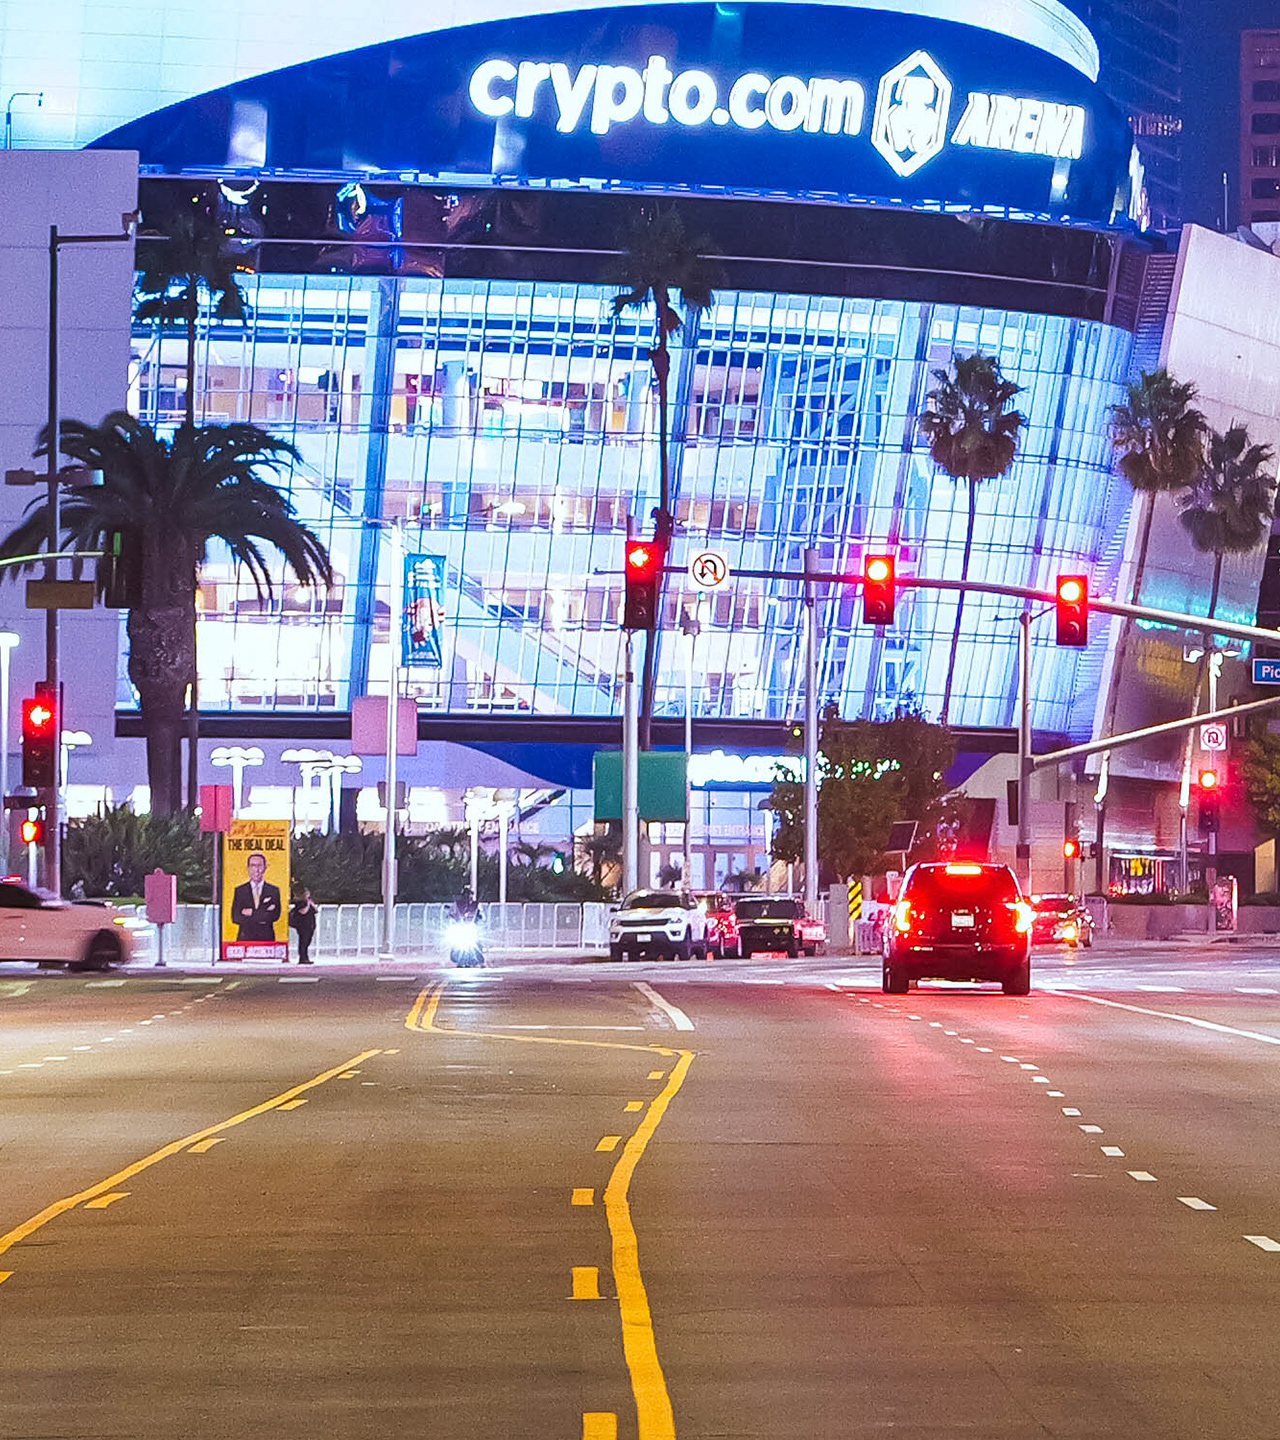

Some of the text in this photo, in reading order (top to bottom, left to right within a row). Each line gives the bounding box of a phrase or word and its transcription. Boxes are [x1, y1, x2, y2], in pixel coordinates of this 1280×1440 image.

[469, 55, 1085, 160] crypto.com ARENA
[228, 839, 285, 851] THE REAL DEAL
